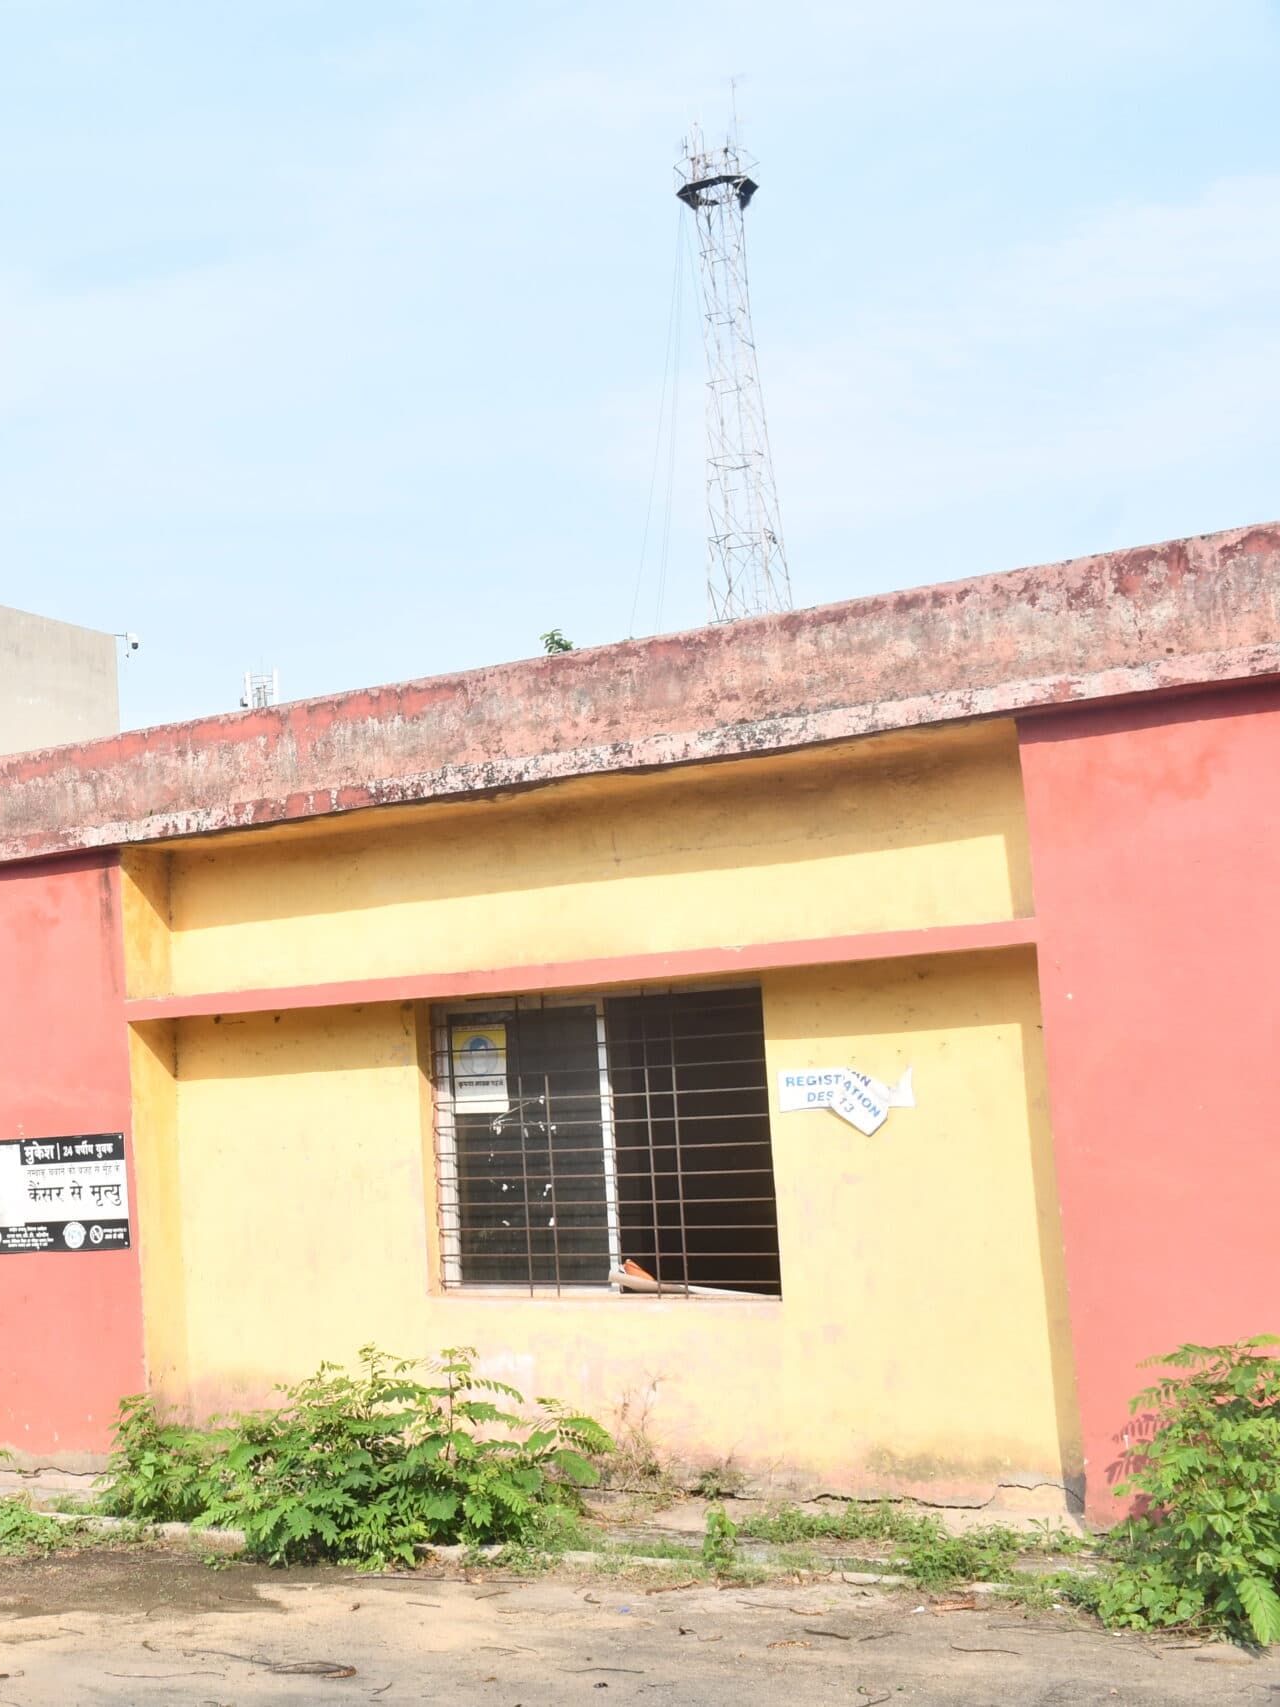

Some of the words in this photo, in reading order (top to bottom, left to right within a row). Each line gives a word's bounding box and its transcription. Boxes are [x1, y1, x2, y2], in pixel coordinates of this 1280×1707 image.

[807, 1091, 835, 1102] DES
[23, 1141, 55, 1165] मुकेश
[63, 1145, 73, 1157] 24
[95, 1143, 114, 1159] युवक
[27, 1180, 65, 1202] कैंसर
[69, 1180, 83, 1201] से
[89, 1184, 122, 1206] मृत्यु
